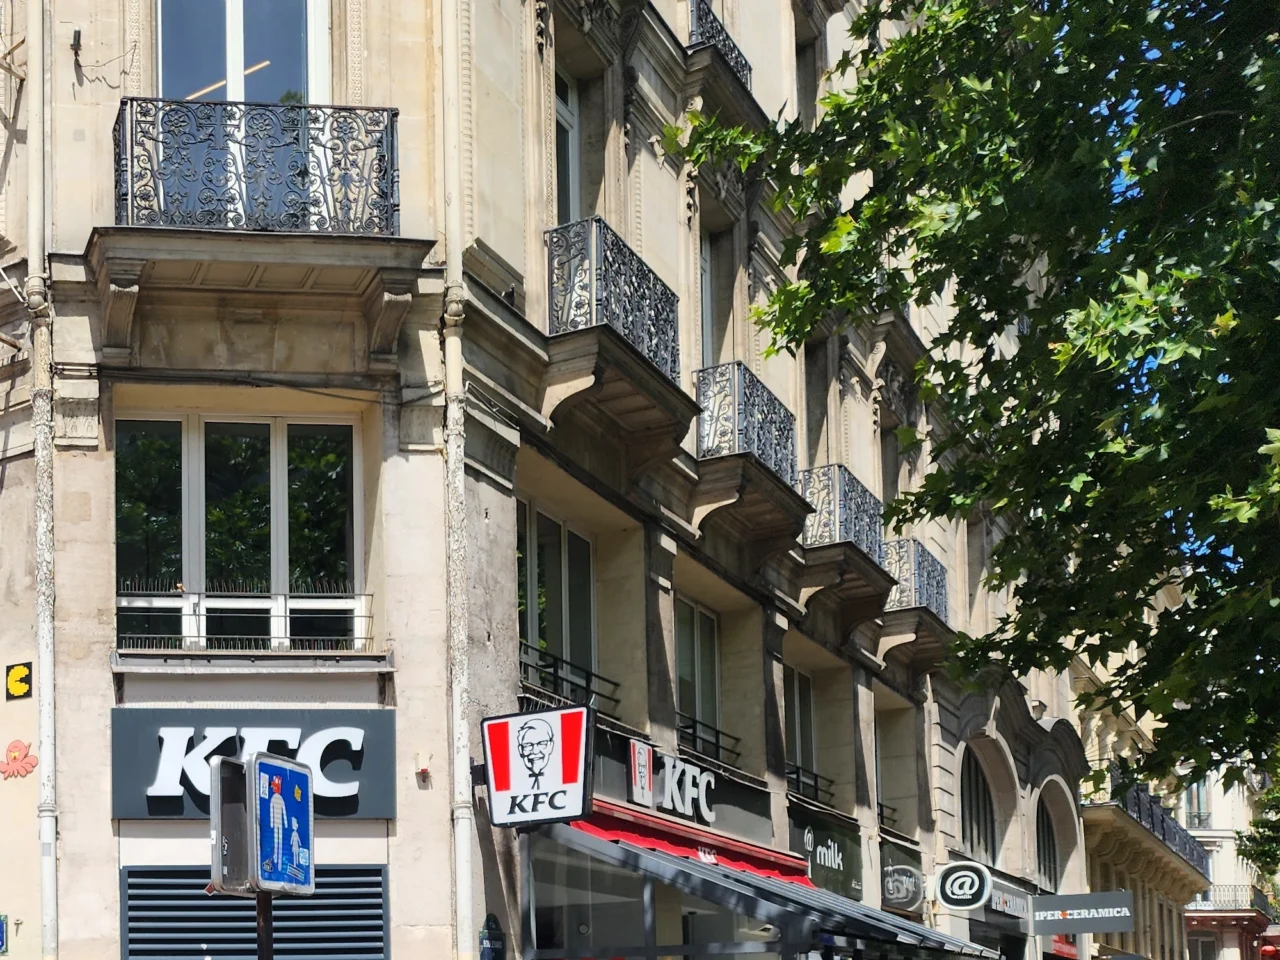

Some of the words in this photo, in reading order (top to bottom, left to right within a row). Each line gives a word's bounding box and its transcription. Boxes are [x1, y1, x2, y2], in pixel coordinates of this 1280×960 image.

[507, 789, 567, 816] KFC
[662, 756, 716, 823] KFC
[816, 838, 844, 871] milk
